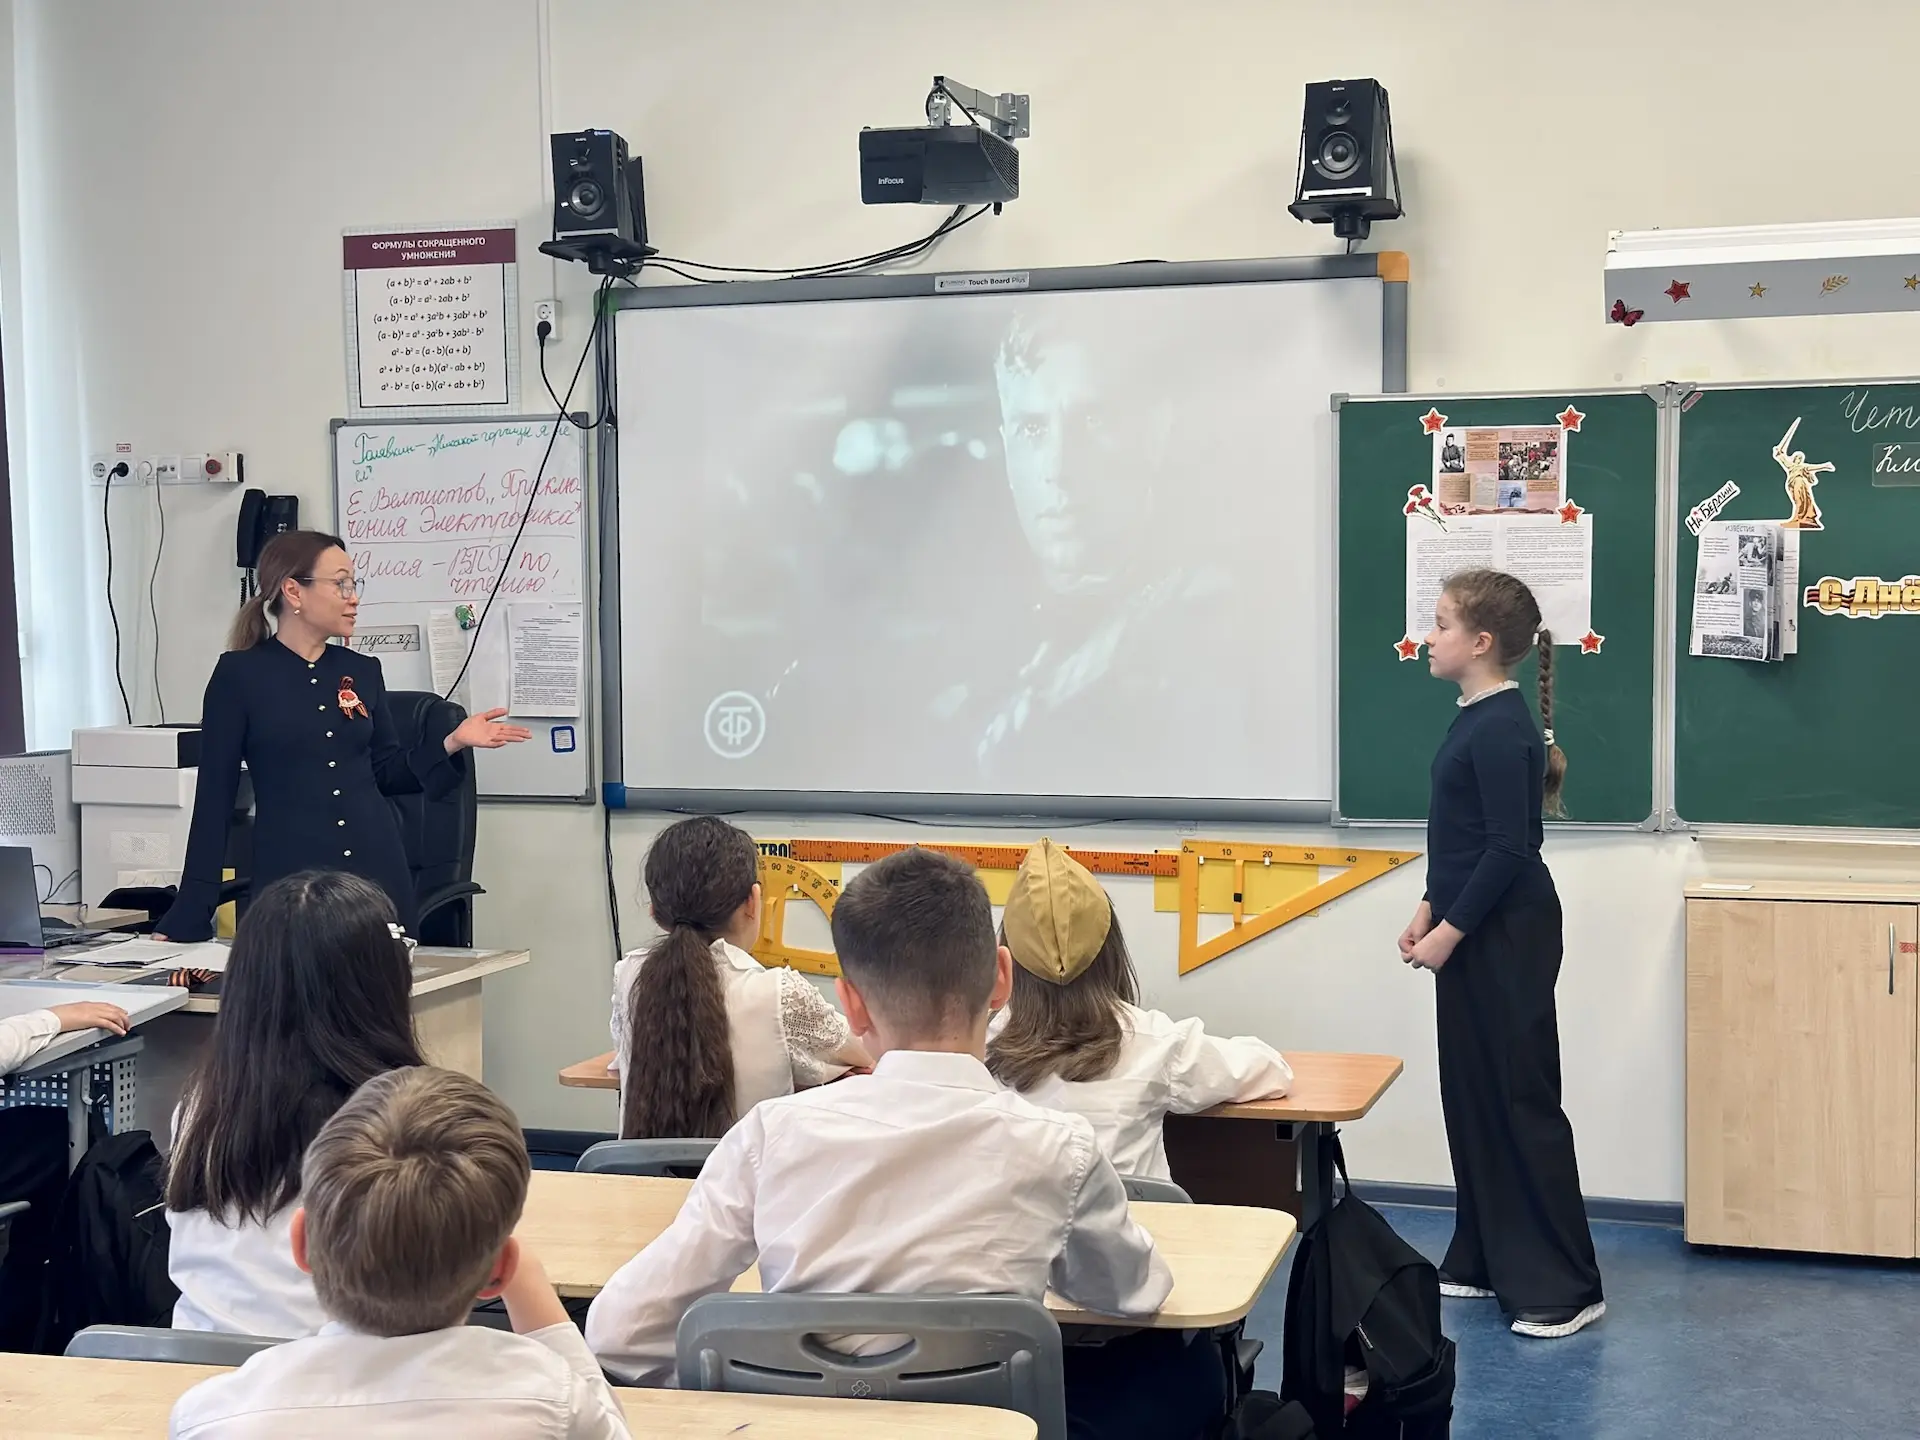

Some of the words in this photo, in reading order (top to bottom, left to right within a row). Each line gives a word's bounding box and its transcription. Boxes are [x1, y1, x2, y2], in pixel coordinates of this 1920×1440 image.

[878, 177, 904, 185] InFocus
[372, 240, 416, 250] ФОРМУЛЫ
[417, 237, 486, 249] СОКРАЩЕННОГО
[401, 250, 457, 260] УМНОЖЕНИЯ
[968, 278, 989, 286] Touch
[1819, 579, 1842, 611] С
[1222, 848, 1232, 856] 10
[1262, 850, 1273, 858] 20
[1304, 852, 1315, 861] 30
[1346, 855, 1357, 863] 40
[1388, 857, 1400, 866] 50
[771, 862, 782, 871] 90
